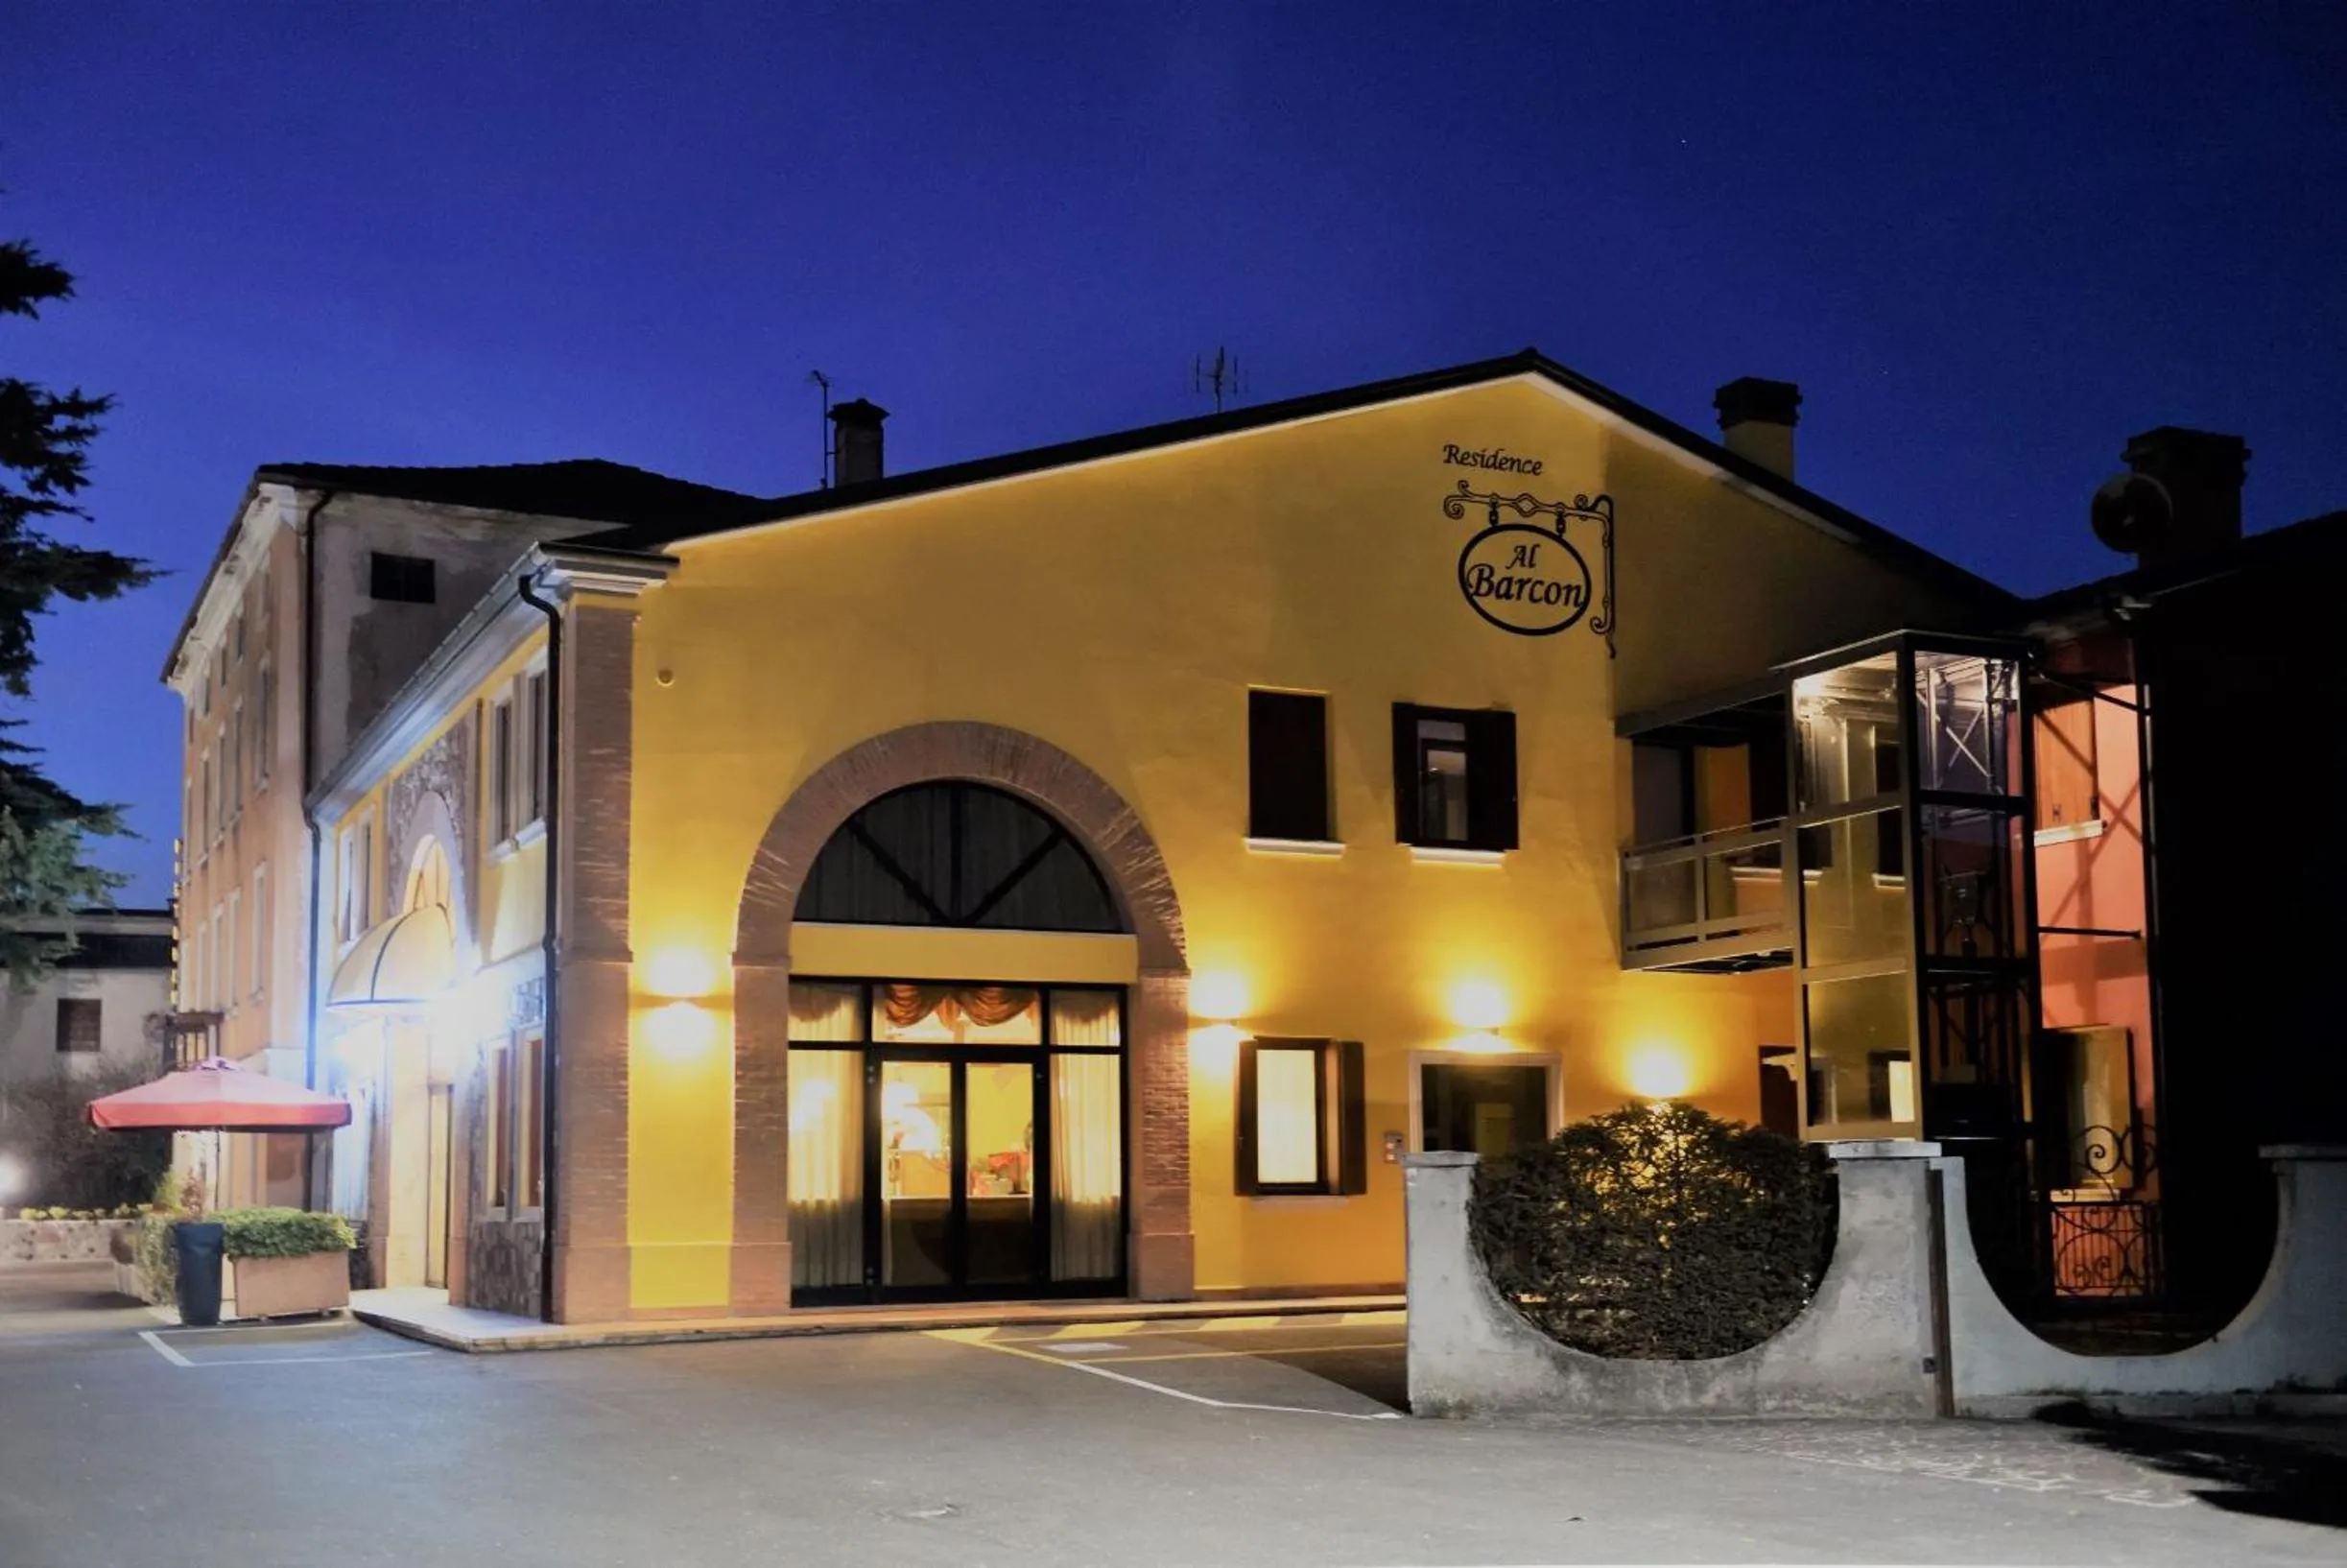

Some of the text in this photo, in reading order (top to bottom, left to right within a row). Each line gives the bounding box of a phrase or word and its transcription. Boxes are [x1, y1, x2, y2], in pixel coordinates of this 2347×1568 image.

[1443, 443, 1544, 476] Residence
[1505, 544, 1541, 570] Al
[1466, 563, 1583, 608] Barcon
